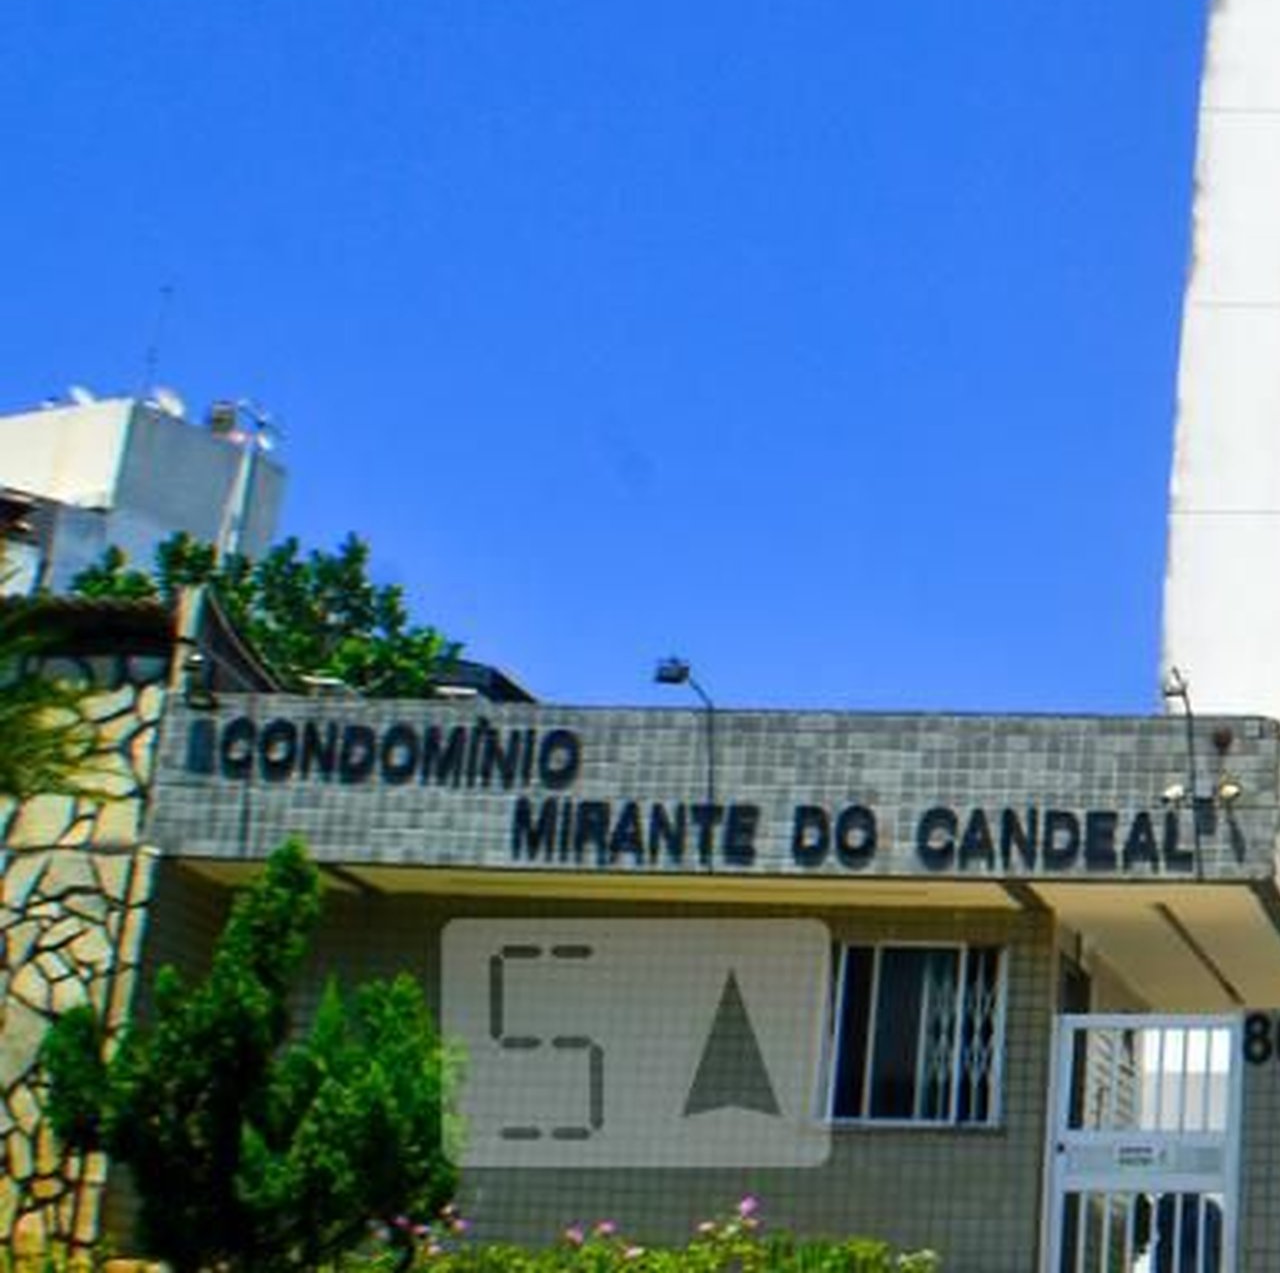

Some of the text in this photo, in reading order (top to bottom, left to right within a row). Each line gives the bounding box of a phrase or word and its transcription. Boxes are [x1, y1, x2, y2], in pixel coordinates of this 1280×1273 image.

[511, 794, 1194, 873] MIRANTE DO CANDEAL
